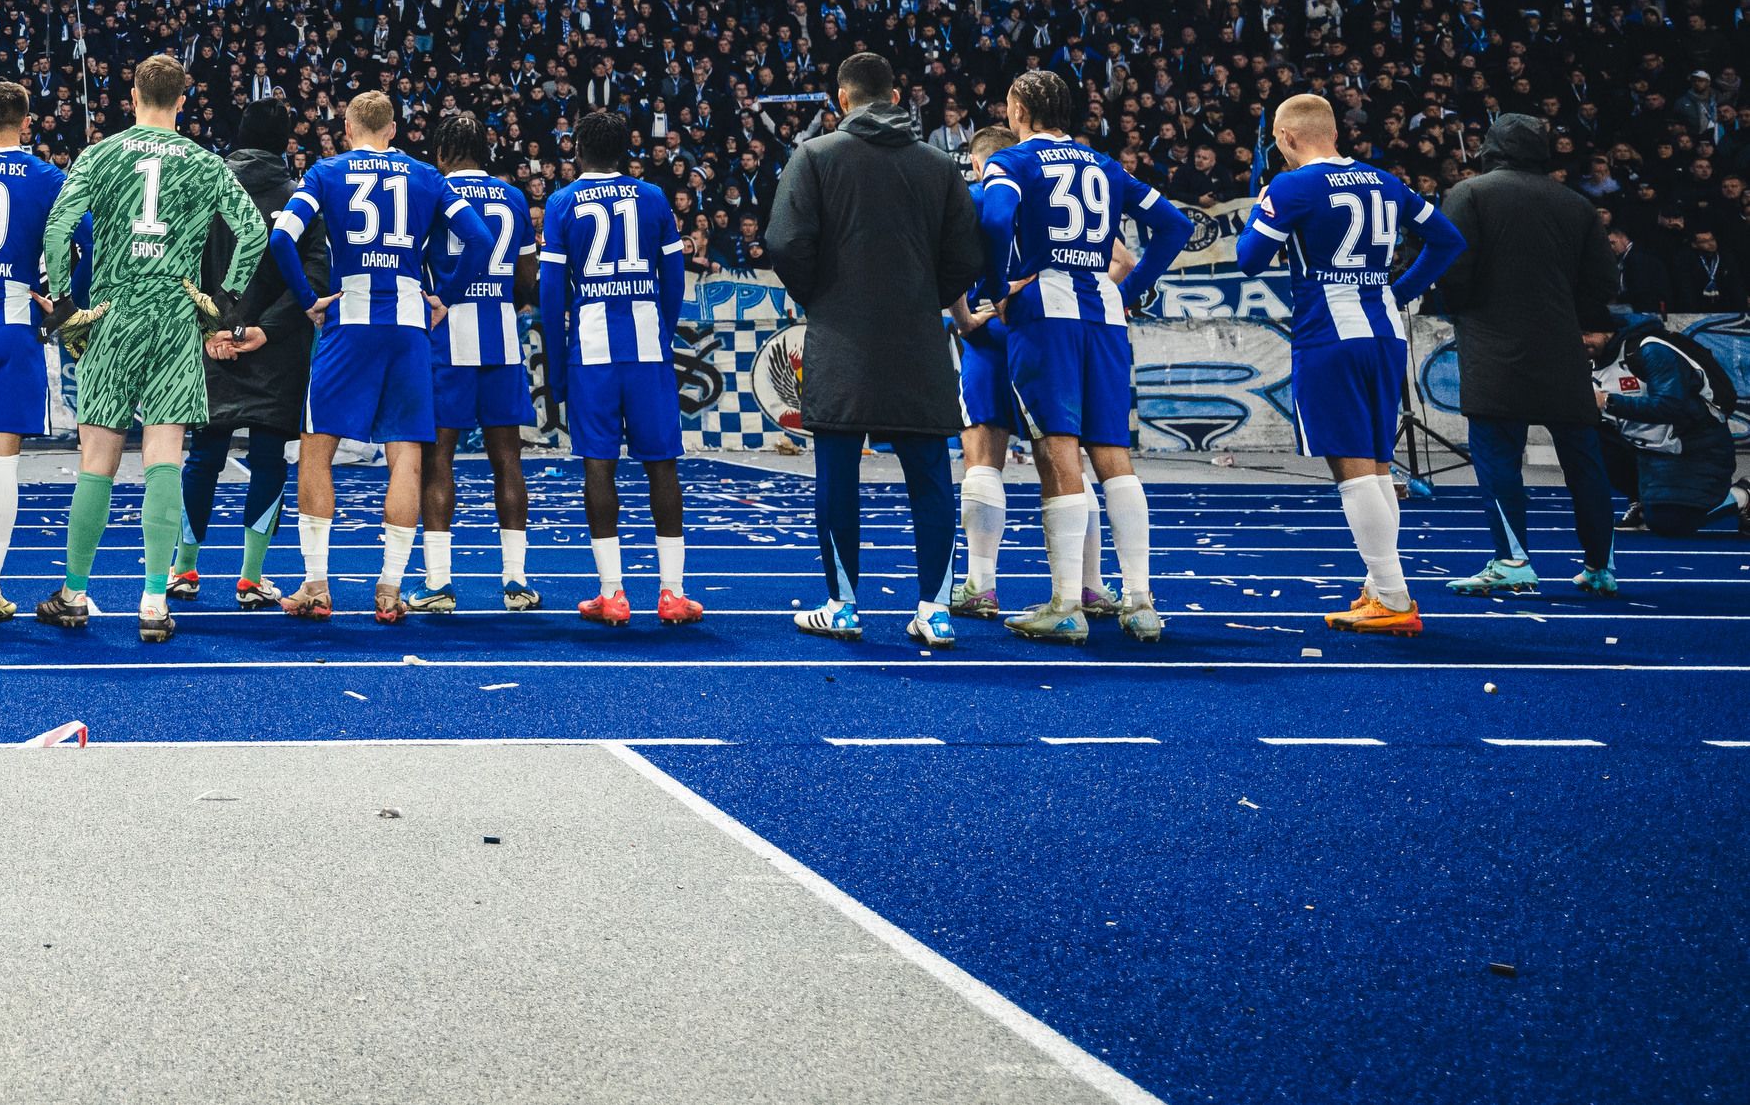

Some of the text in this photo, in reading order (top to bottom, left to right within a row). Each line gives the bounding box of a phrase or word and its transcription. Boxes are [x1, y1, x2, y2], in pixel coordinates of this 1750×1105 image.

[122, 139, 188, 159] HERTHA BSC
[1036, 147, 1080, 164] HERTHA
[9, 163, 28, 177] BSC
[348, 158, 411, 175] HERTHA BSC
[1325, 171, 1366, 187] HERTHA
[132, 158, 168, 236] 1
[455, 185, 508, 201] ERTHA BSC
[574, 185, 640, 203] HERTHA BSC
[345, 172, 415, 249] 31
[1041, 163, 1111, 244] 39
[574, 197, 650, 278] 21
[1328, 189, 1398, 269] 24
[131, 241, 165, 258] ERNST
[361, 250, 400, 269] DÁRDAI
